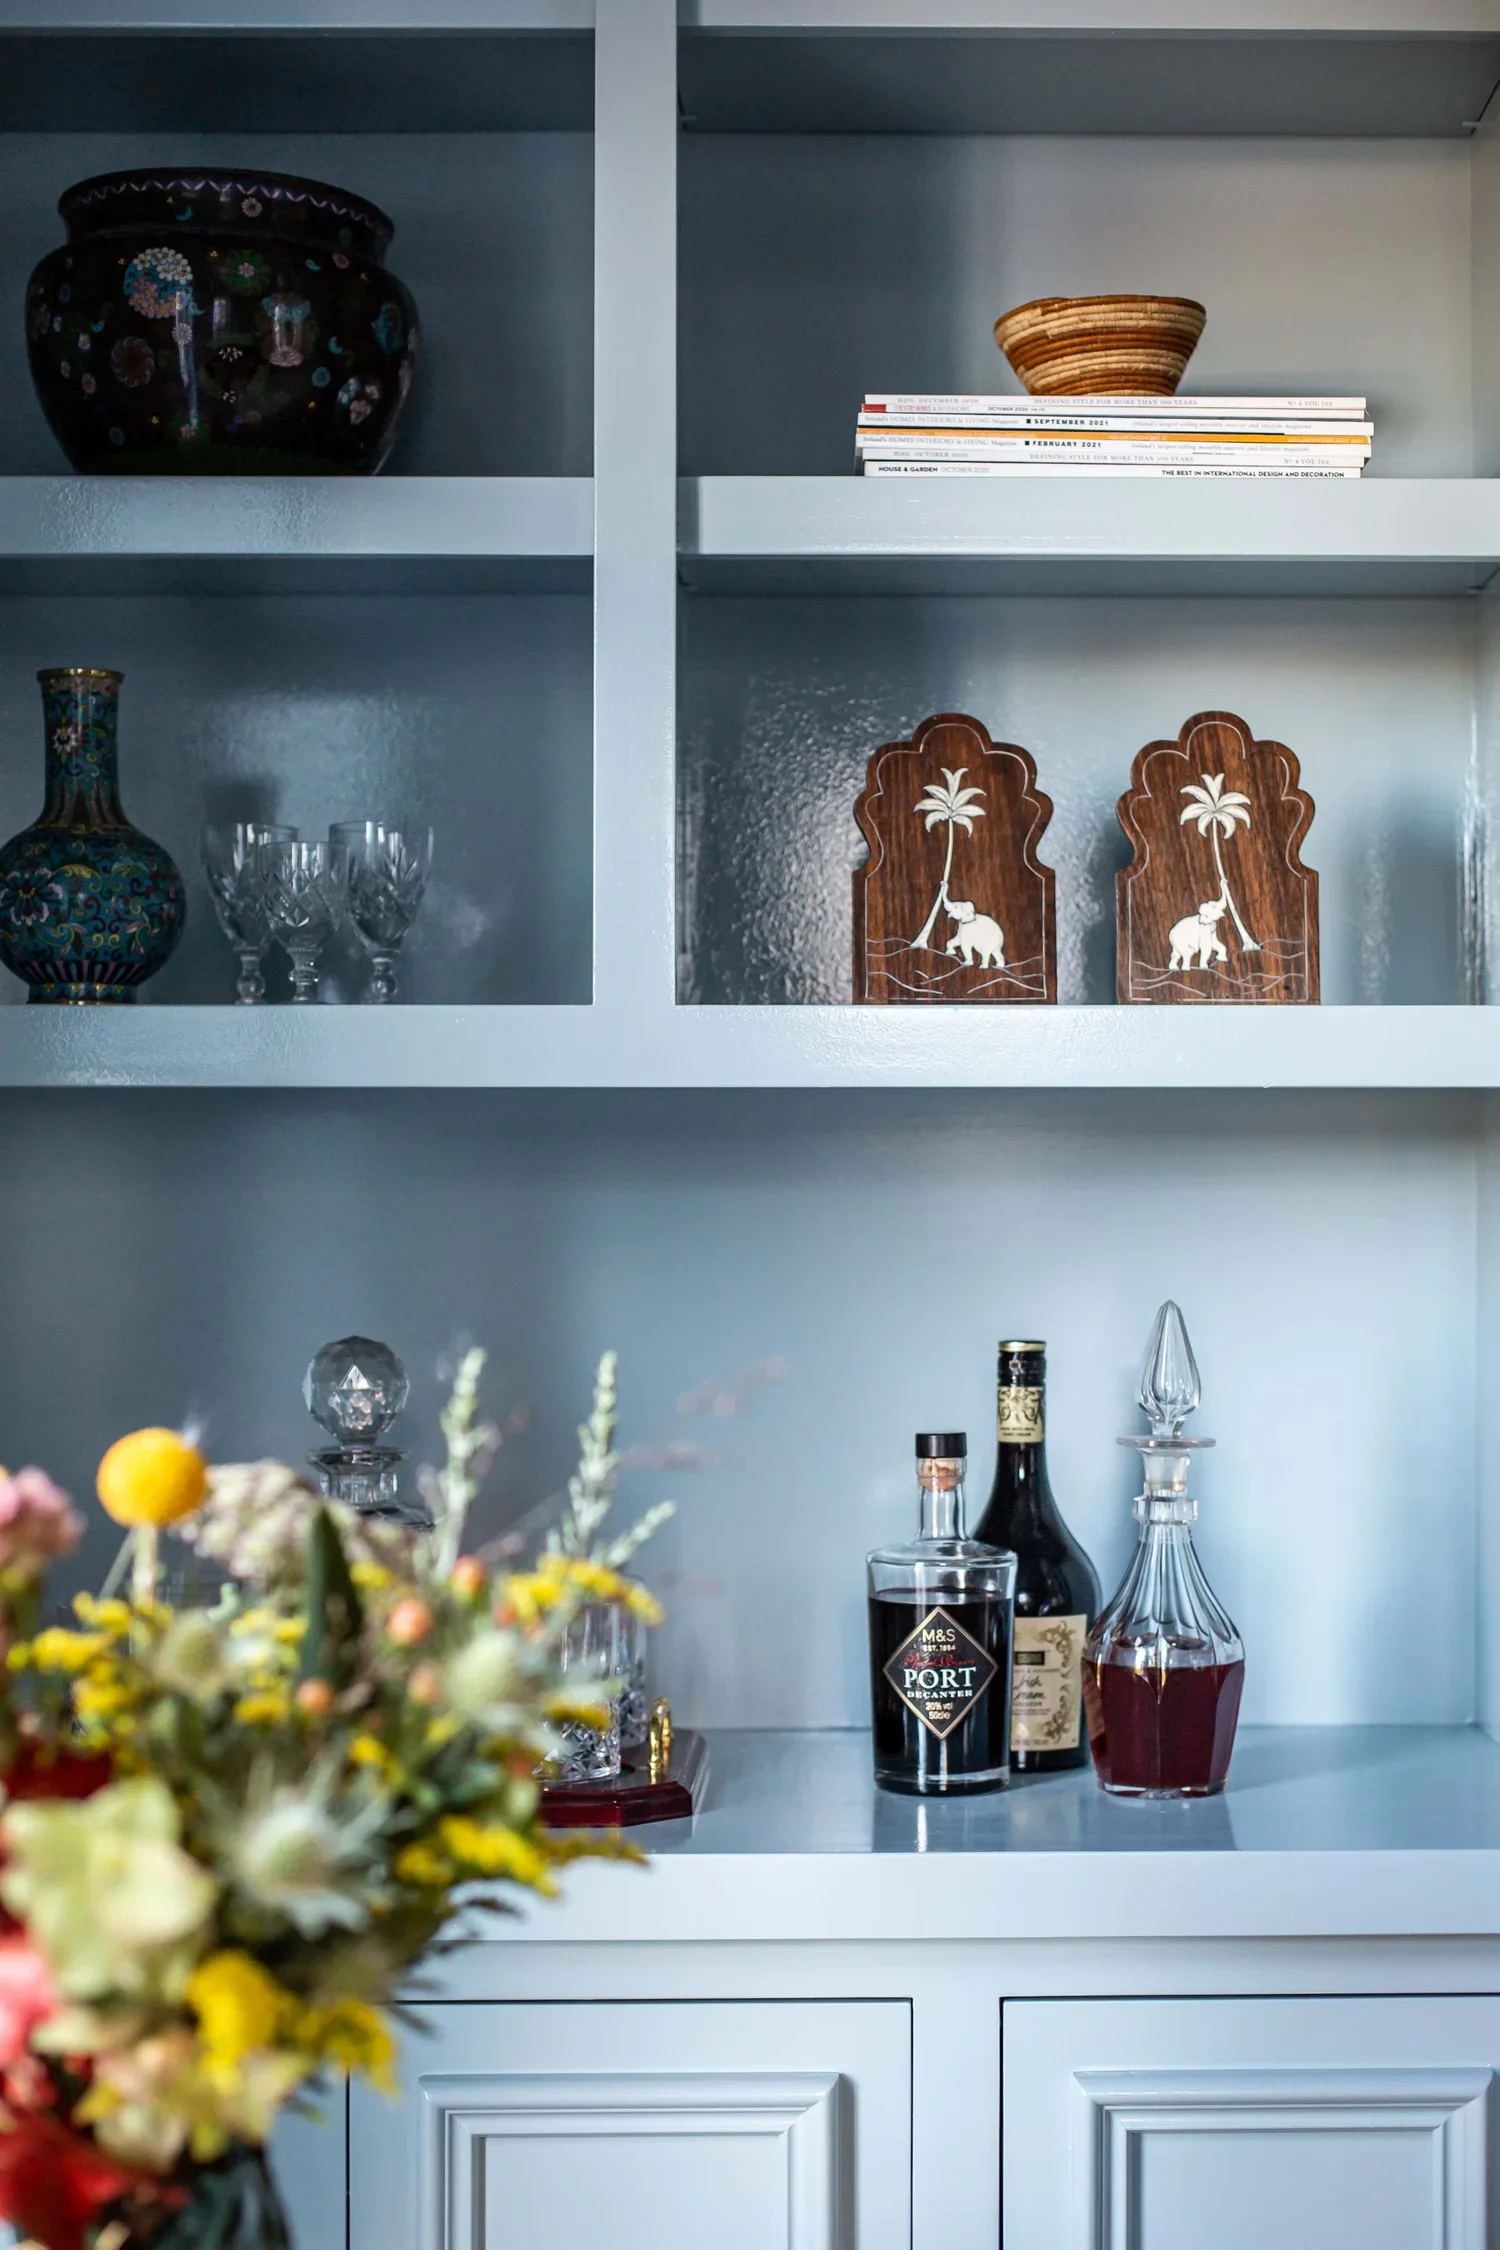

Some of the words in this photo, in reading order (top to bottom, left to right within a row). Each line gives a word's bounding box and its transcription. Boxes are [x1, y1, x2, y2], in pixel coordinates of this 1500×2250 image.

[922, 1628, 956, 1643] M&S
[921, 1644, 938, 1652] EST.
[903, 1666, 977, 1689] PORT
[906, 1690, 973, 1699] DECANTER
[925, 1702, 942, 1711] 20%
[942, 1702, 953, 1710] vol
